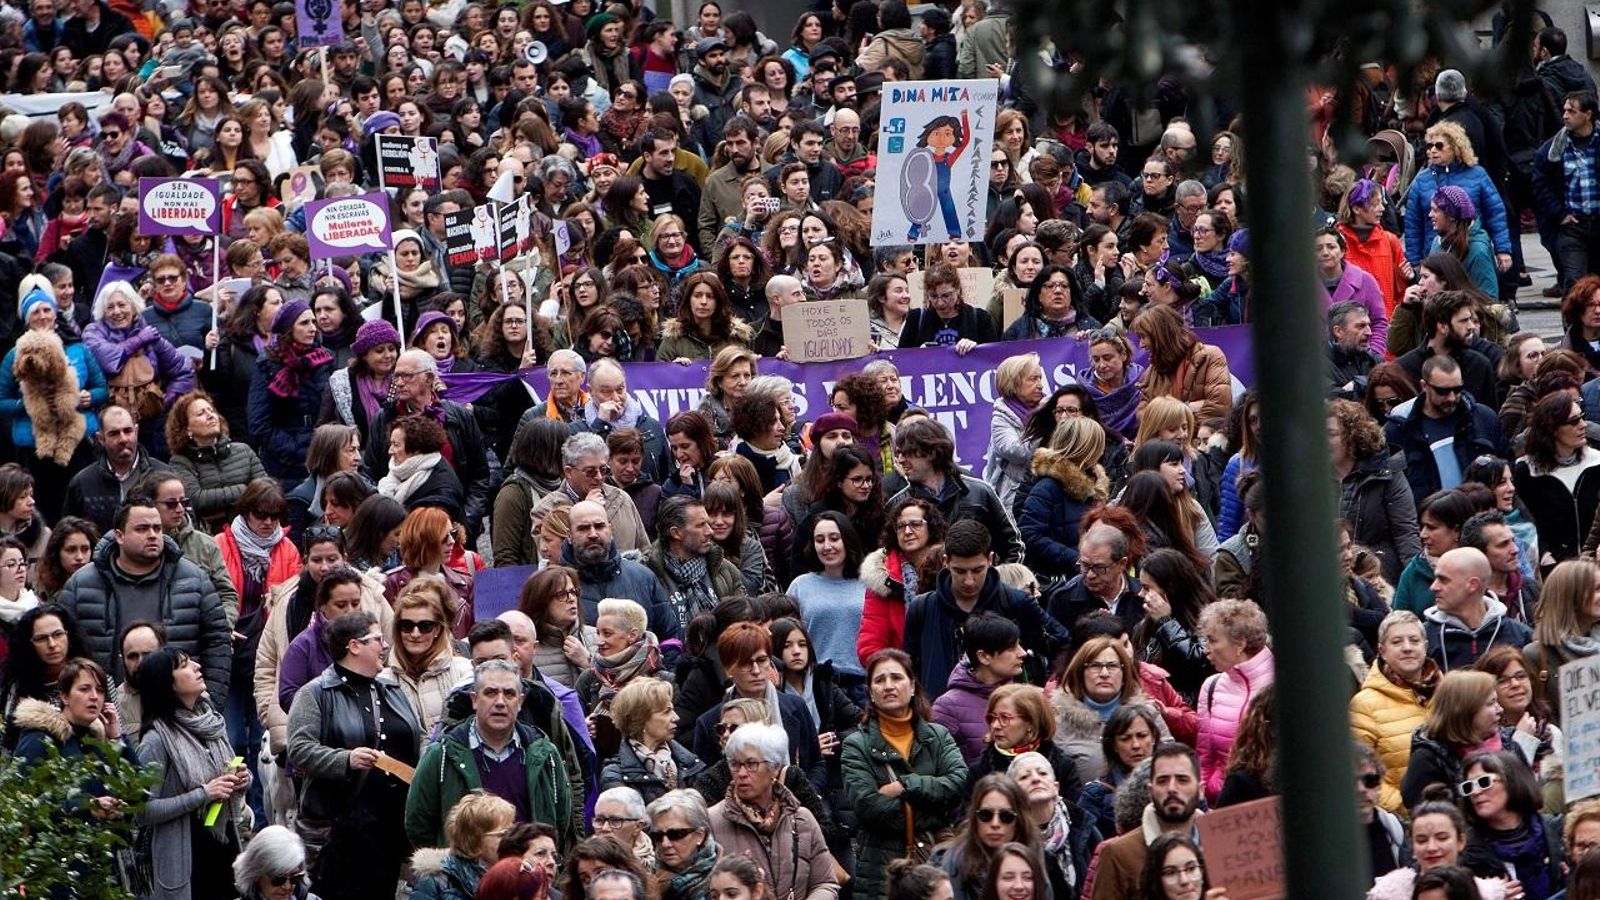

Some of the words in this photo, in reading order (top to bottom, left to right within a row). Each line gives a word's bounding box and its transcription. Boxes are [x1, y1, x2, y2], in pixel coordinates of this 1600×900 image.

[171, 182, 189, 191] SEN
[155, 191, 205, 199] IGUALDADE
[151, 207, 206, 219] LIBERDADE
[328, 219, 373, 231] Mulleres
[323, 226, 380, 241] LIBERADAS
[801, 305, 830, 316] HOXE
[807, 317, 836, 329] TODOS
[840, 316, 852, 325] OS
